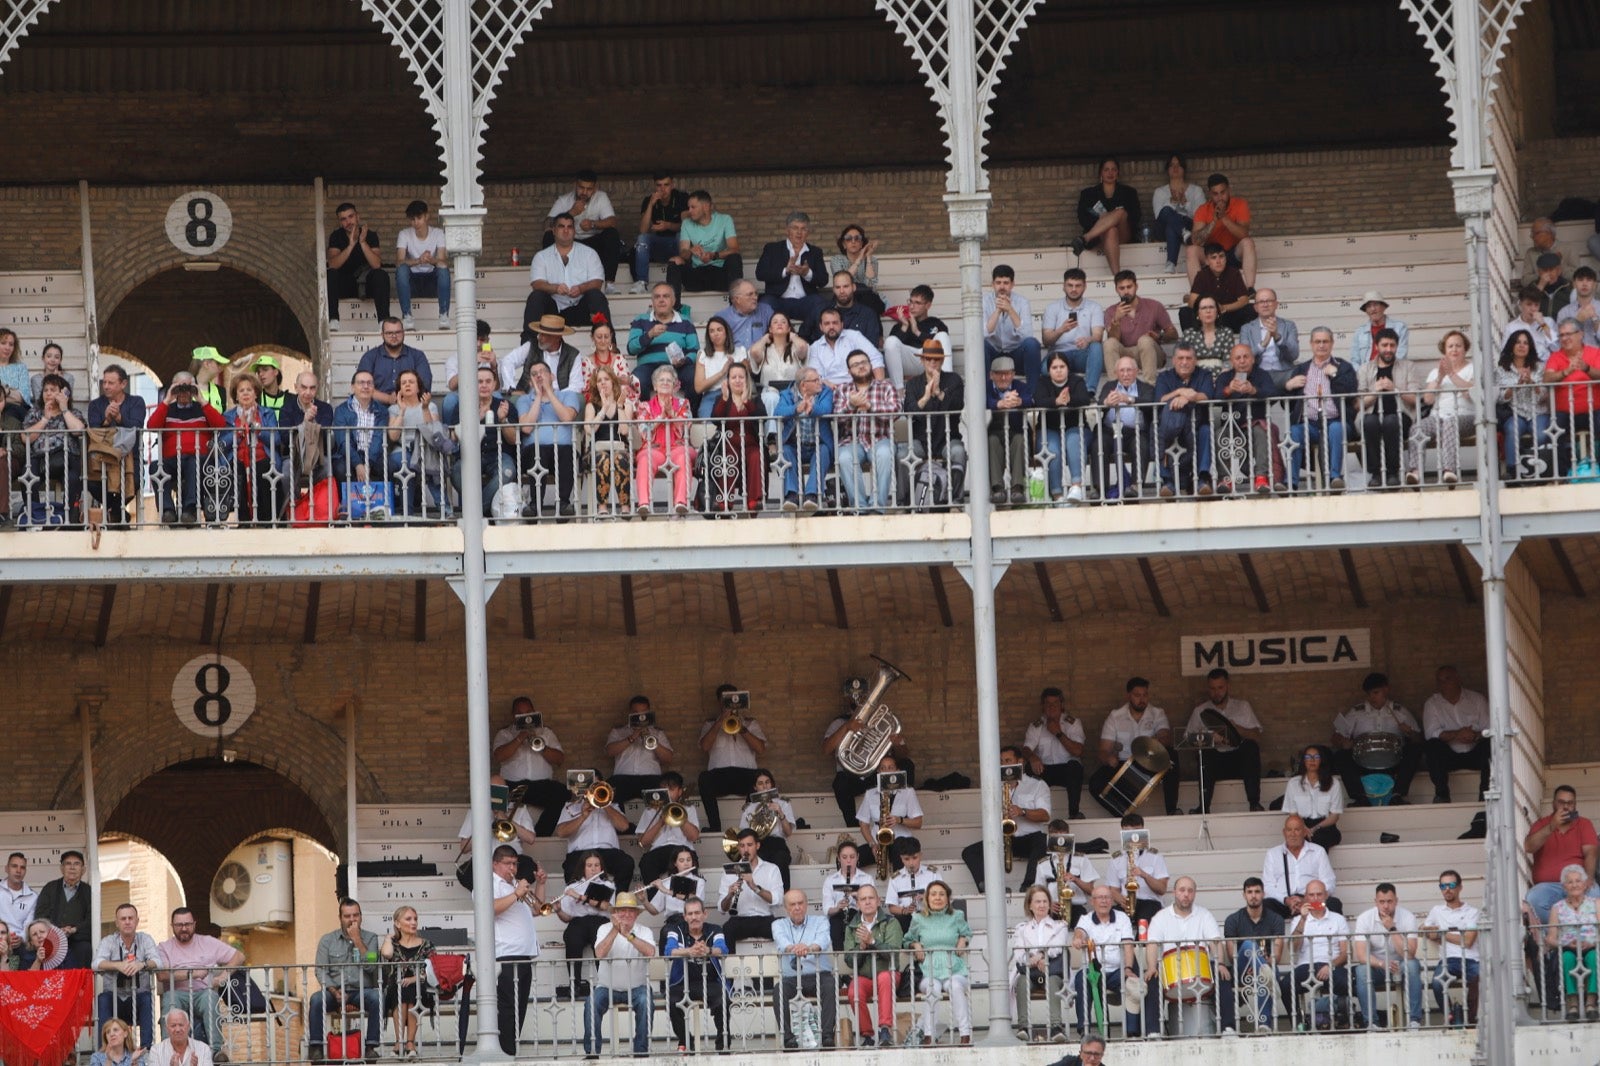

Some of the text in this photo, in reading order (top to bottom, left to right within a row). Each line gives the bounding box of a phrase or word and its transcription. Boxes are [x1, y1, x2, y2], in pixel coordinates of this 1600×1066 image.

[185, 198, 216, 247] 8
[1194, 635, 1358, 668] MUSICA
[193, 663, 232, 726] 8
